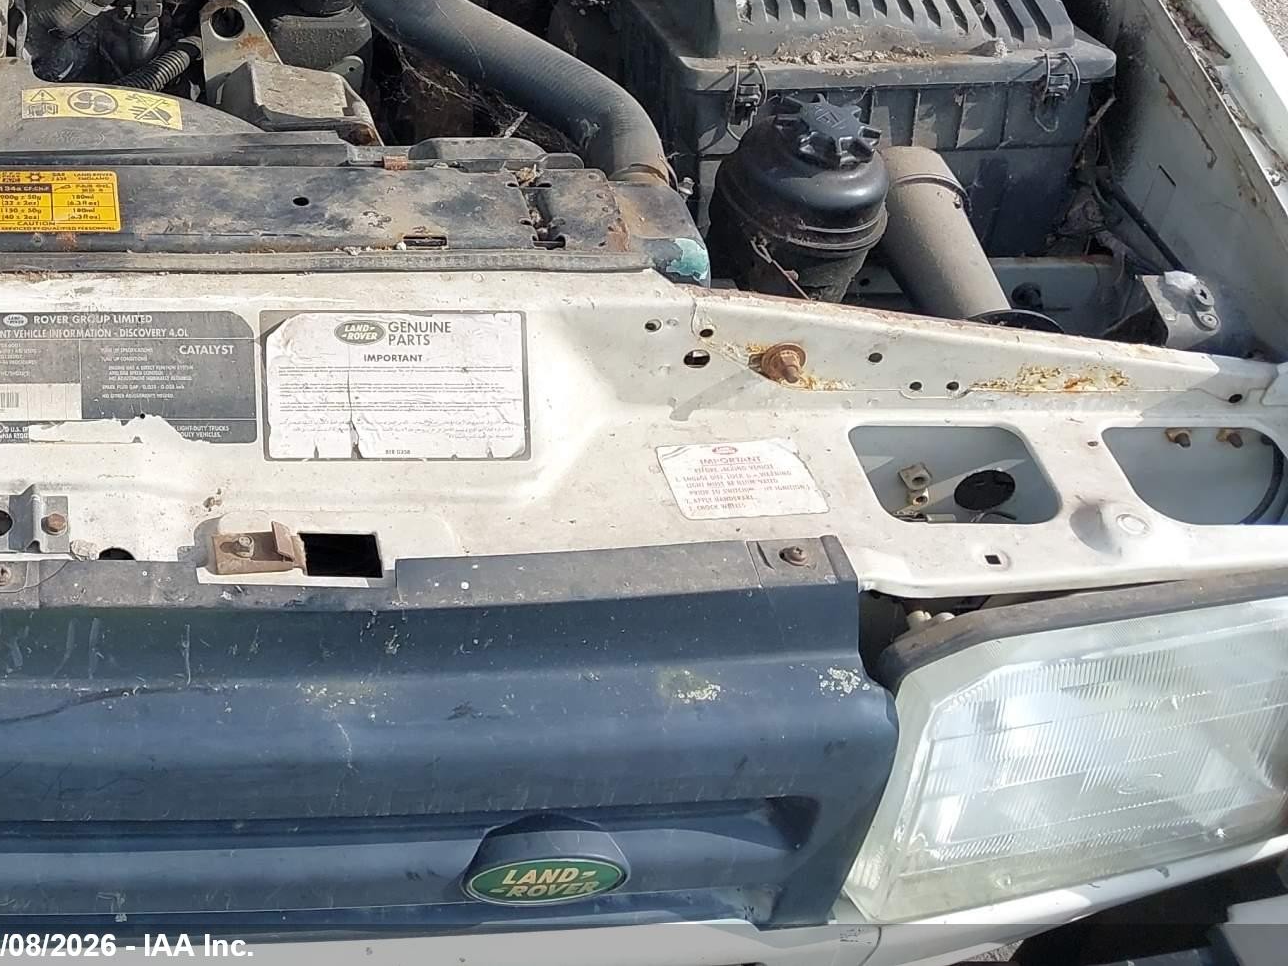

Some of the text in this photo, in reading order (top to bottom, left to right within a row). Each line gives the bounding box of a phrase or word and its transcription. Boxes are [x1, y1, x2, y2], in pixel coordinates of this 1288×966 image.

[33, 315, 69, 324] ROVER
[72, 315, 110, 324] GROUP
[113, 314, 153, 323] LIMITED
[388, 322, 452, 333] GENUINE
[12, 329, 46, 338] VEHICLE
[49, 329, 111, 338] INFORMATION
[120, 328, 167, 337] DISCOVERY
[168, 328, 189, 337] 4.0L
[388, 334, 431, 346] PARTS
[179, 345, 234, 354] CATALYST
[364, 354, 423, 362] IMPORTANT
